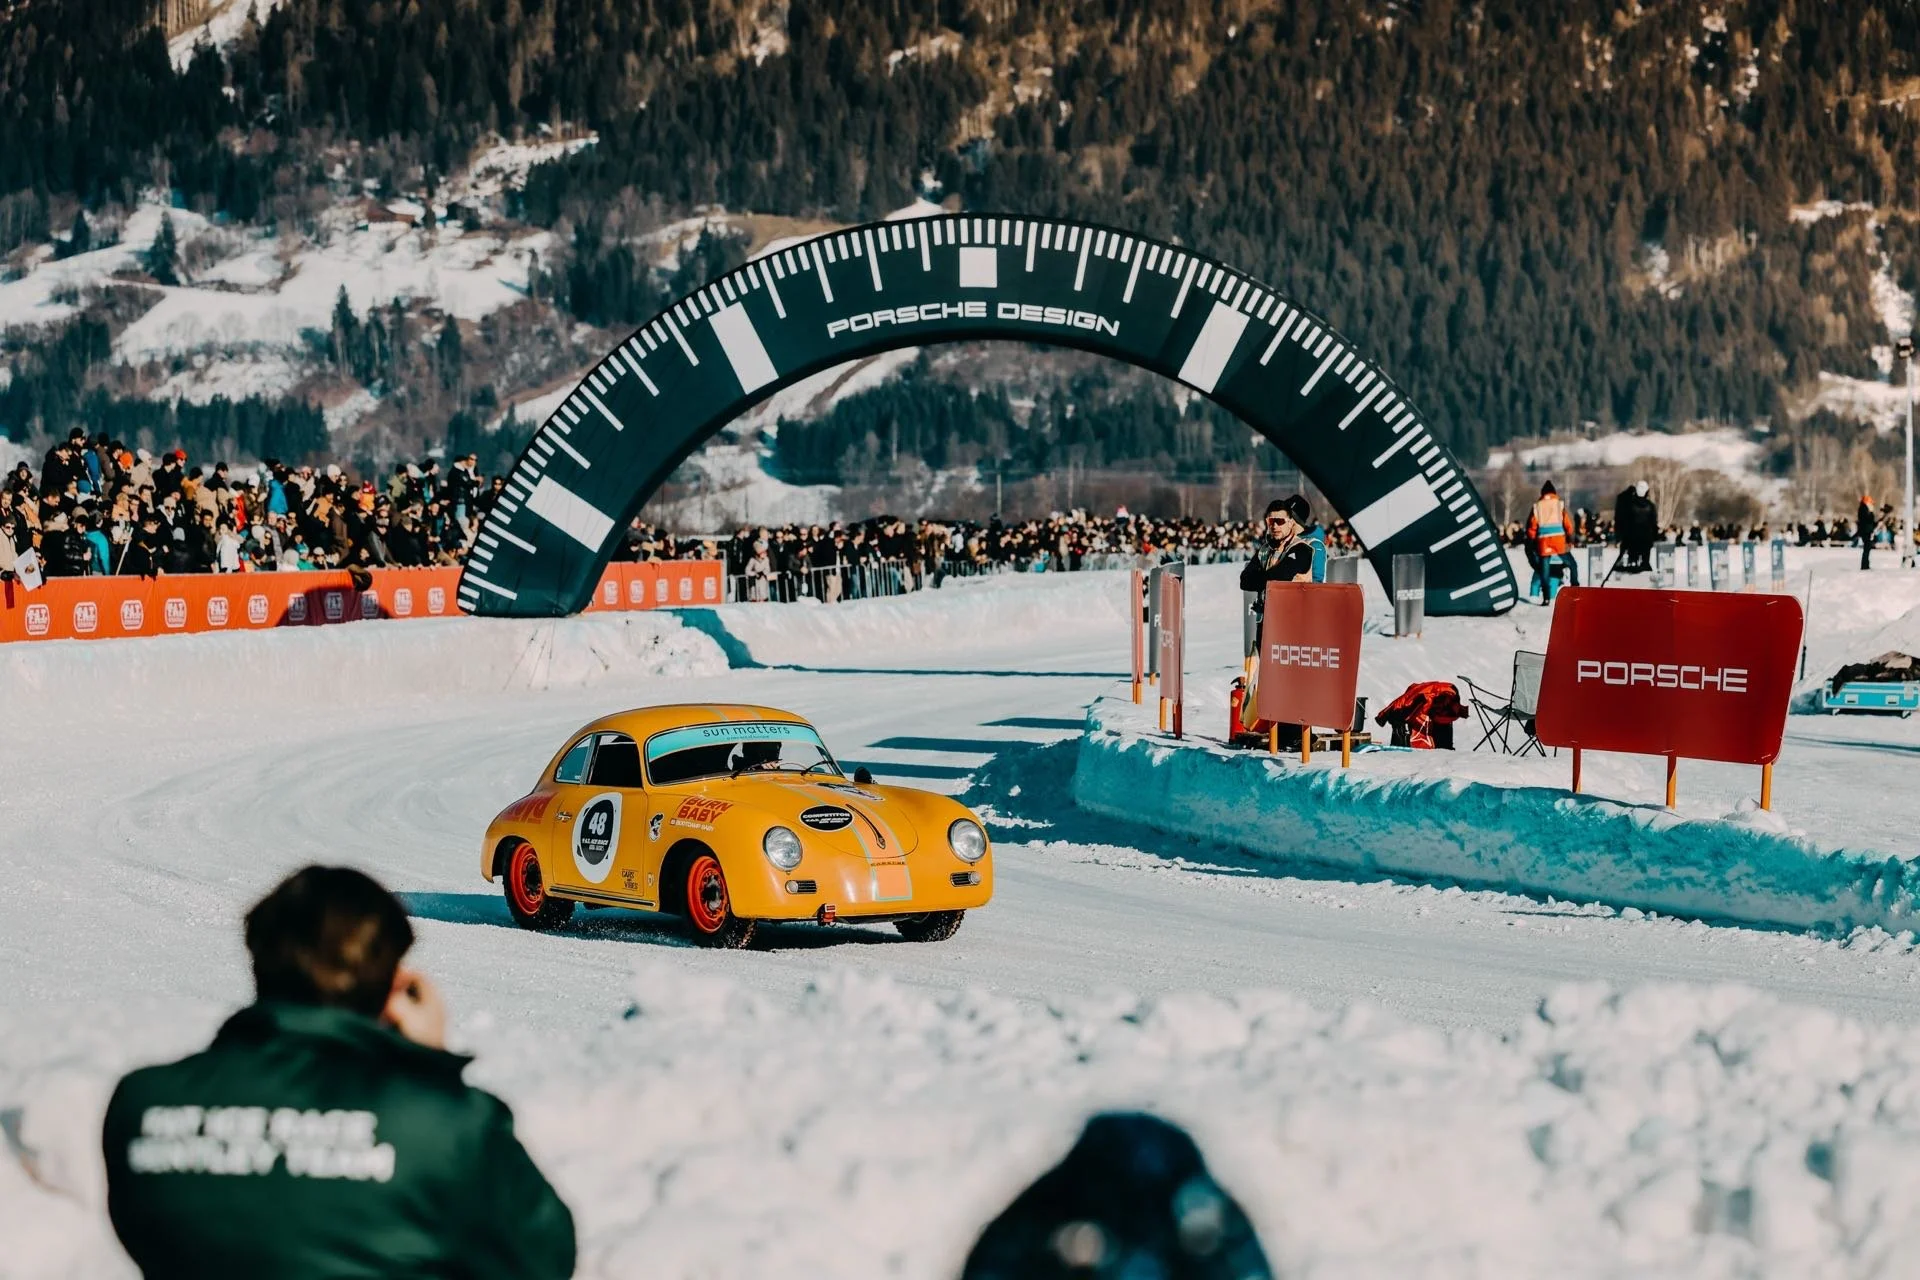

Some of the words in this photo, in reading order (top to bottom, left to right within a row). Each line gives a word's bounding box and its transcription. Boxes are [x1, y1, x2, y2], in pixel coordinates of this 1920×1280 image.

[826, 301, 987, 339] PORSCHE
[997, 302, 1120, 337] DESIGN
[1271, 644, 1340, 669] PORSCHE
[1577, 660, 1748, 693] PORSCHE
[702, 727, 730, 737] sun
[731, 724, 791, 735] matters
[677, 805, 722, 823] BABY
[685, 796, 734, 811] BURN
[588, 812, 608, 836] 48
